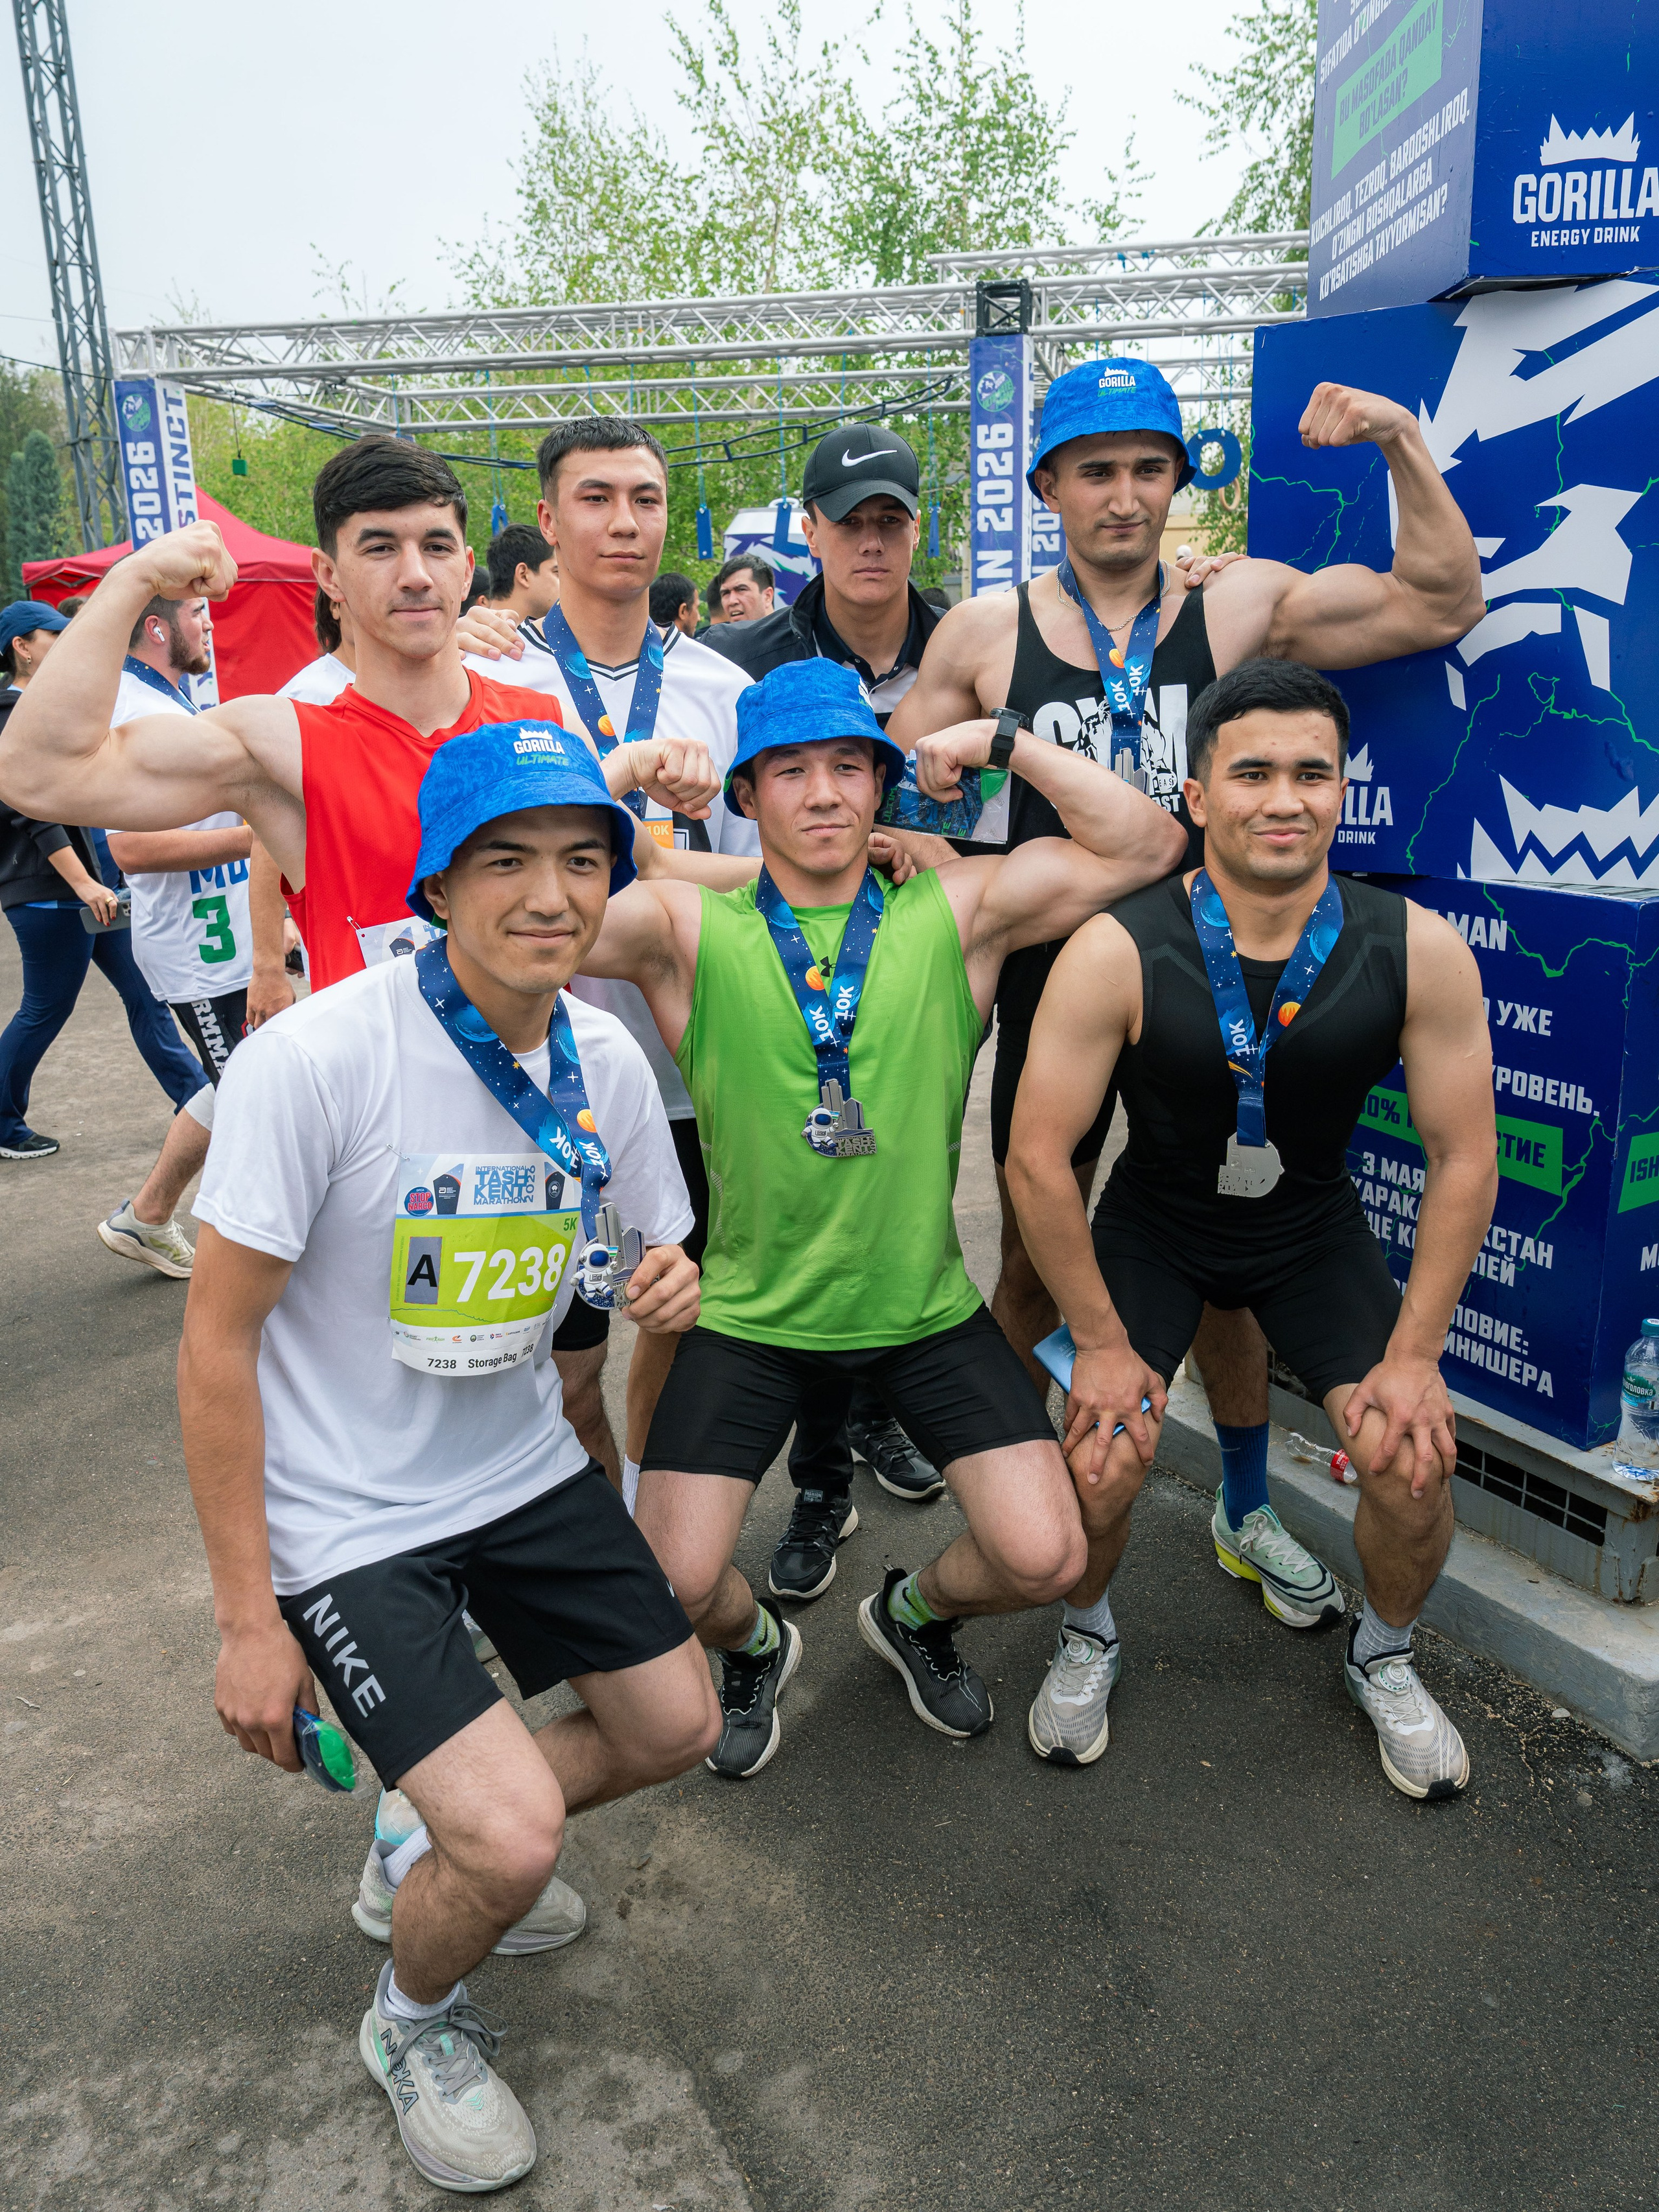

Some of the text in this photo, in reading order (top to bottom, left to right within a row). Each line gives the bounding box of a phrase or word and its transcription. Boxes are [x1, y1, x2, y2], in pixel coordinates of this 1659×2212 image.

[1320, 24, 1352, 85] SIFATIDA
[1340, 0, 1438, 127] BU MASOFADA QANDAY
[1332, 156, 1433, 261] O'ZINGNI BOSHQALARGA
[1513, 167, 1659, 224] GORILLA
[1319, 182, 1448, 301] KO'RSATISHGA TAYYORMISAN?
[1531, 225, 1641, 247] ENERGY DRINK
[1097, 386, 1137, 397] ULTIMATE
[1098, 375, 1136, 388] GORILLA
[126, 441, 165, 540] 2026
[977, 423, 1014, 532] 2026
[1110, 680, 1131, 714] 10K
[513, 739, 565, 756] GORILLA
[516, 754, 569, 767] ULTIMATE
[1338, 830, 1376, 844] DRINK
[192, 894, 237, 964] 3
[1446, 911, 1507, 951] MAN
[835, 984, 854, 1021] 10K
[1496, 999, 1553, 1036] УЖЕ
[809, 1005, 834, 1042] 10K
[1228, 1018, 1251, 1056] 10K
[1361, 1093, 1400, 1125] 0%
[474, 1183, 527, 1200] KENT
[475, 1170, 529, 1186] TASH
[526, 1165, 536, 1203] 2026
[1381, 1158, 1425, 1193] МАЯ
[408, 1201, 433, 1211] NARCO
[409, 1193, 431, 1204] STOP
[473, 1197, 528, 1205] MARATHON
[563, 1217, 578, 1232] 5K
[1640, 1237, 1659, 1272] M
[407, 1253, 438, 1288] A
[454, 1242, 566, 1303] 7238
[427, 1343, 535, 1369] 7238 Storage Bag 7238
[302, 1593, 386, 1719] NIKE
